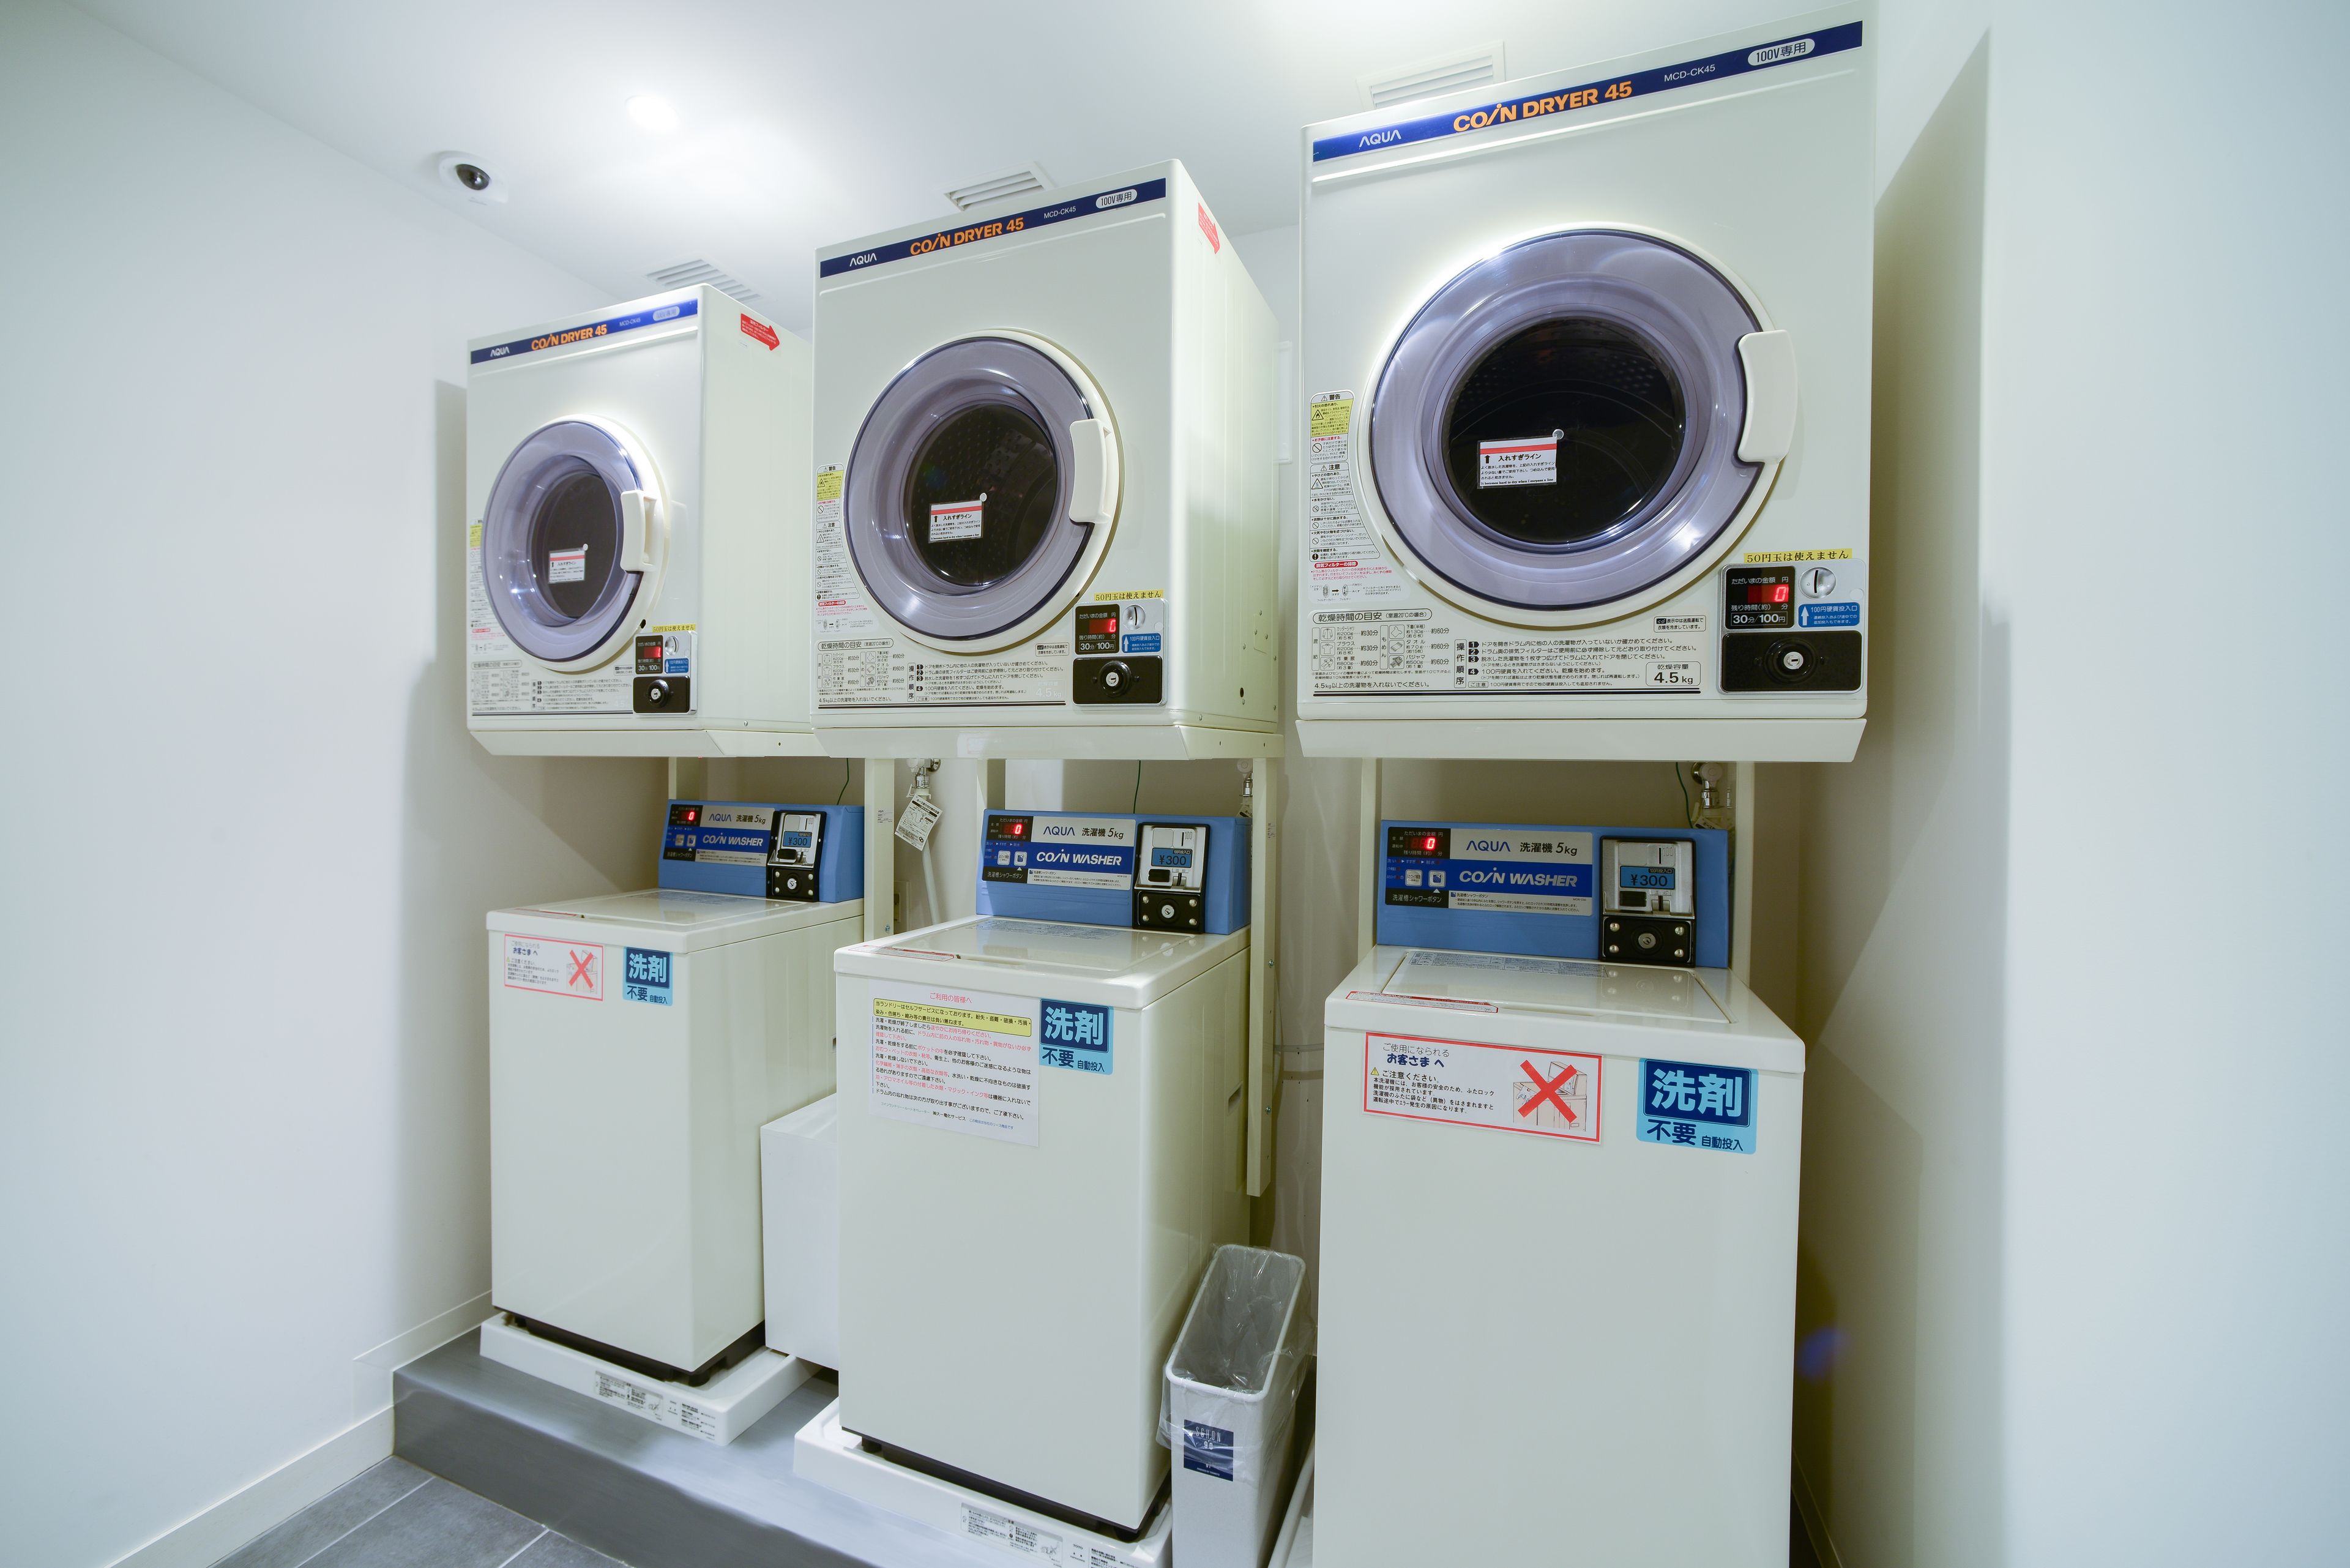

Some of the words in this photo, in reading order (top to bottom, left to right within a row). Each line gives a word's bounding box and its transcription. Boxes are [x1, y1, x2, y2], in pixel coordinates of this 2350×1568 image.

[1755, 42, 1808, 63] 100V専用
[1663, 64, 1716, 82] MCD-CK45
[1522, 89, 1598, 119] DRYER
[1605, 80, 1632, 102] 45
[1359, 132, 1401, 147] AQUA
[1101, 192, 1132, 206] 100V専用
[1044, 206, 1076, 219] MCD-CK45
[955, 223, 1002, 245] DRYER
[1007, 218, 1024, 231] 45
[849, 253, 876, 267] AQUA
[561, 329, 593, 345] DRYER
[595, 324, 607, 336] 45
[490, 347, 510, 357] AQUA
[1499, 454, 1541, 462] 入れすぎライン
[1747, 550, 1848, 562] 50円玉は使えません
[1095, 591, 1162, 600] 50円玉は使えません
[1775, 586, 1787, 602] 0
[1318, 612, 1382, 622] 乾燥時間の目安
[1654, 672, 1679, 683] 4.5
[688, 812, 695, 820] 0
[754, 815, 766, 824] 5kg
[1015, 825, 1021, 834] 0
[1043, 826, 1075, 836] AQUA
[1082, 827, 1105, 837] 洗濯機
[1108, 828, 1124, 840] 5kg
[728, 837, 763, 846] WASHER
[1427, 838, 1435, 848] 0
[1466, 840, 1510, 853] AQUA
[1520, 842, 1553, 853] 洗濯機
[1556, 842, 1577, 856] 5kg
[1072, 854, 1122, 866] WASHER
[1159, 856, 1186, 866] ¥300
[1510, 873, 1577, 887] WASHER
[1631, 875, 1667, 886] ¥300
[629, 953, 666, 983] 洗剤
[627, 985, 647, 1001] 不要
[930, 993, 972, 1003] ご利用の皆様へ
[1045, 1007, 1103, 1045] 洗剤
[1383, 1043, 1449, 1058] ご使用になられる
[1042, 1047, 1074, 1068] 不要
[1078, 1060, 1104, 1072] 自動投入
[1387, 1053, 1430, 1067] お客さま
[1434, 1059, 1444, 1067] へ
[1382, 1070, 1439, 1083] ご注意ください。
[1652, 1069, 1742, 1116] 洗剤
[1647, 1119, 1696, 1145] 不要
[1702, 1136, 1743, 1151] 自動投入
